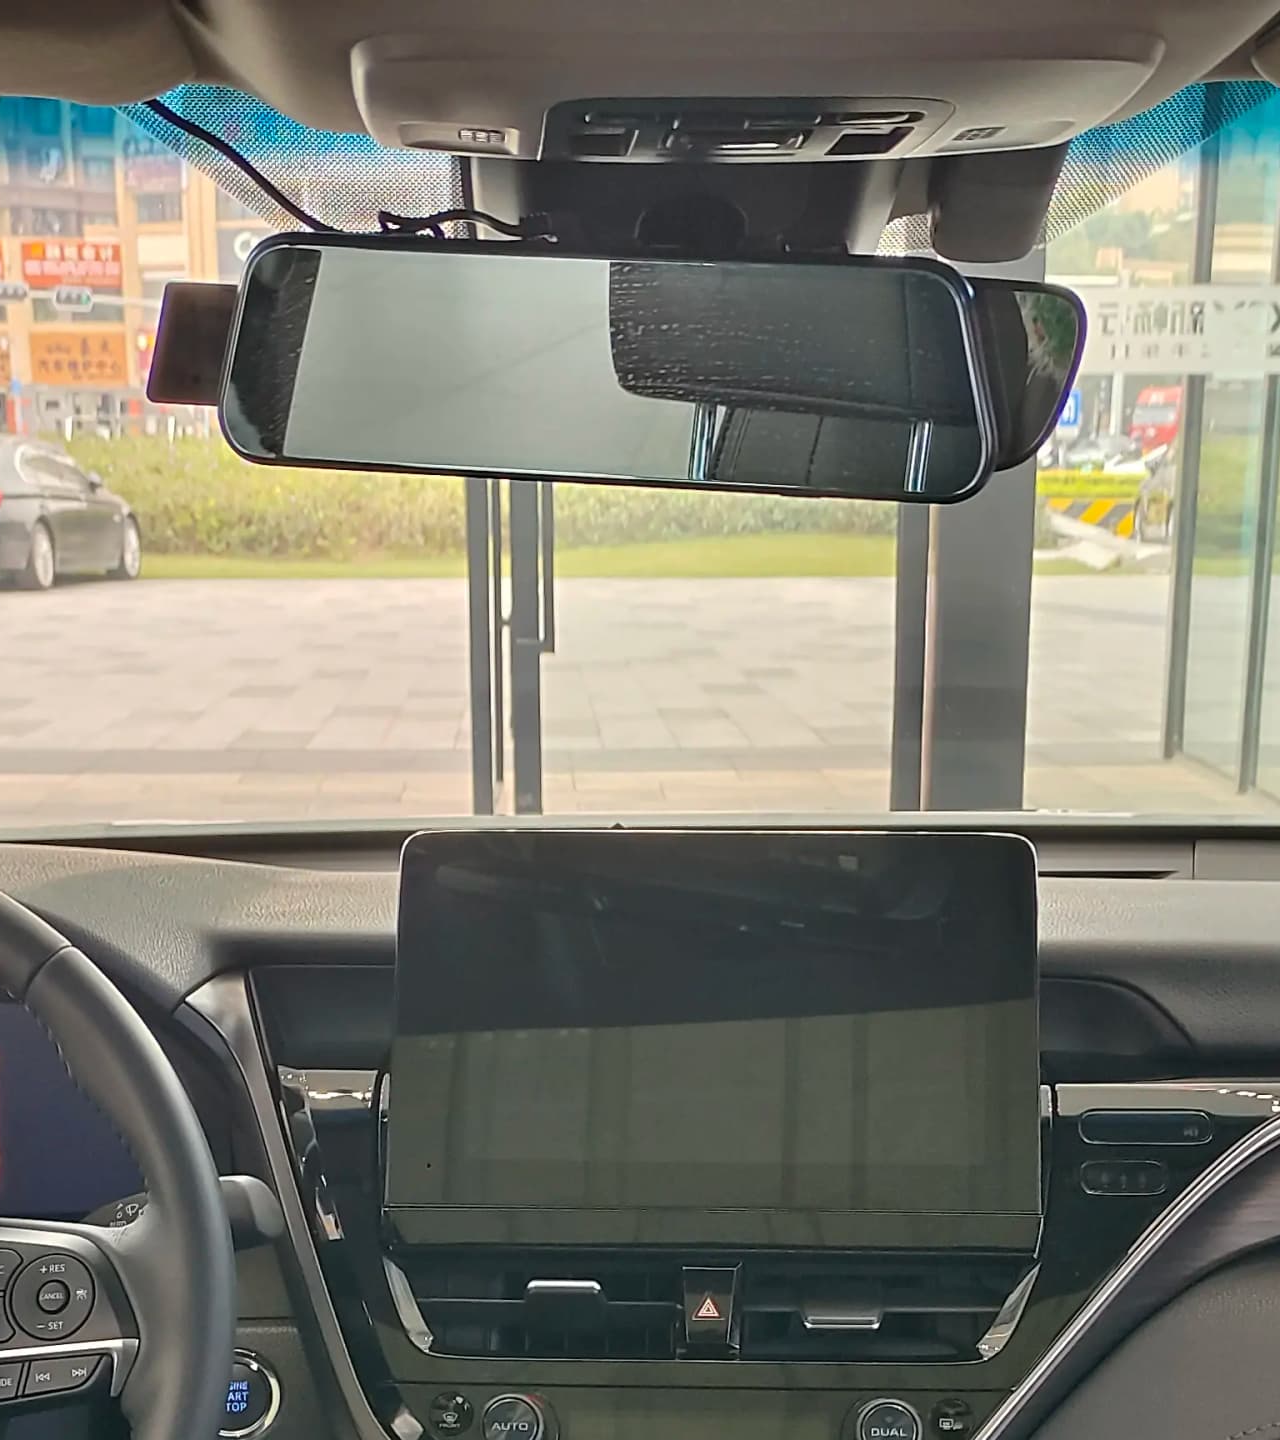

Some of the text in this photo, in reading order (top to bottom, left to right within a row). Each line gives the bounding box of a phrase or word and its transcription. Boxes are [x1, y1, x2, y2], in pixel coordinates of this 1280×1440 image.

[38, 1292, 65, 1301] CANCEL
[227, 1391, 249, 1402] ART
[226, 1402, 247, 1412] TOP
[491, 1421, 529, 1432] AUTO
[870, 1427, 908, 1438] DUAL
